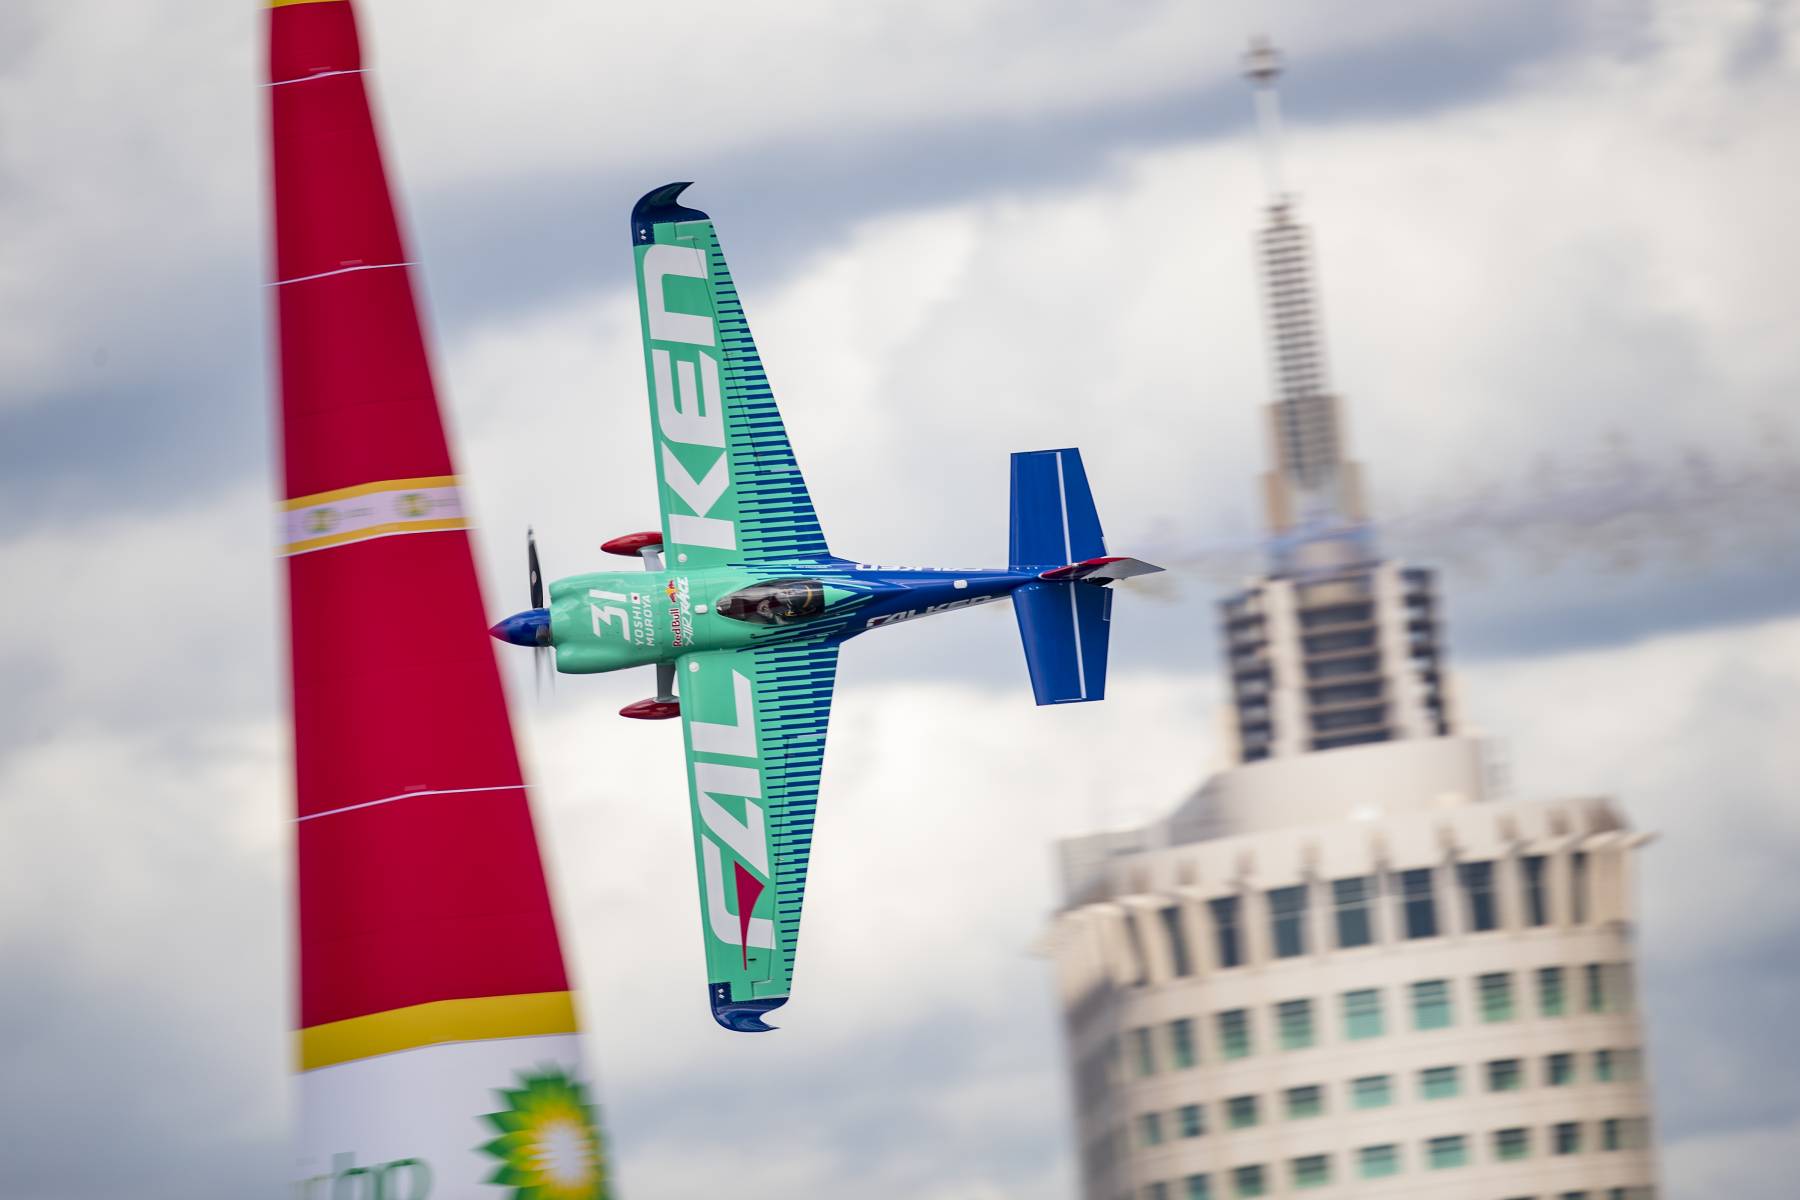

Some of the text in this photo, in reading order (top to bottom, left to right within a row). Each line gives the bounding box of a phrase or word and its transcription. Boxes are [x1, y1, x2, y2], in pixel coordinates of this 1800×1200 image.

[589, 589, 631, 641] 31
[632, 606, 645, 646] YOSHI
[642, 595, 655, 646] MUROYA
